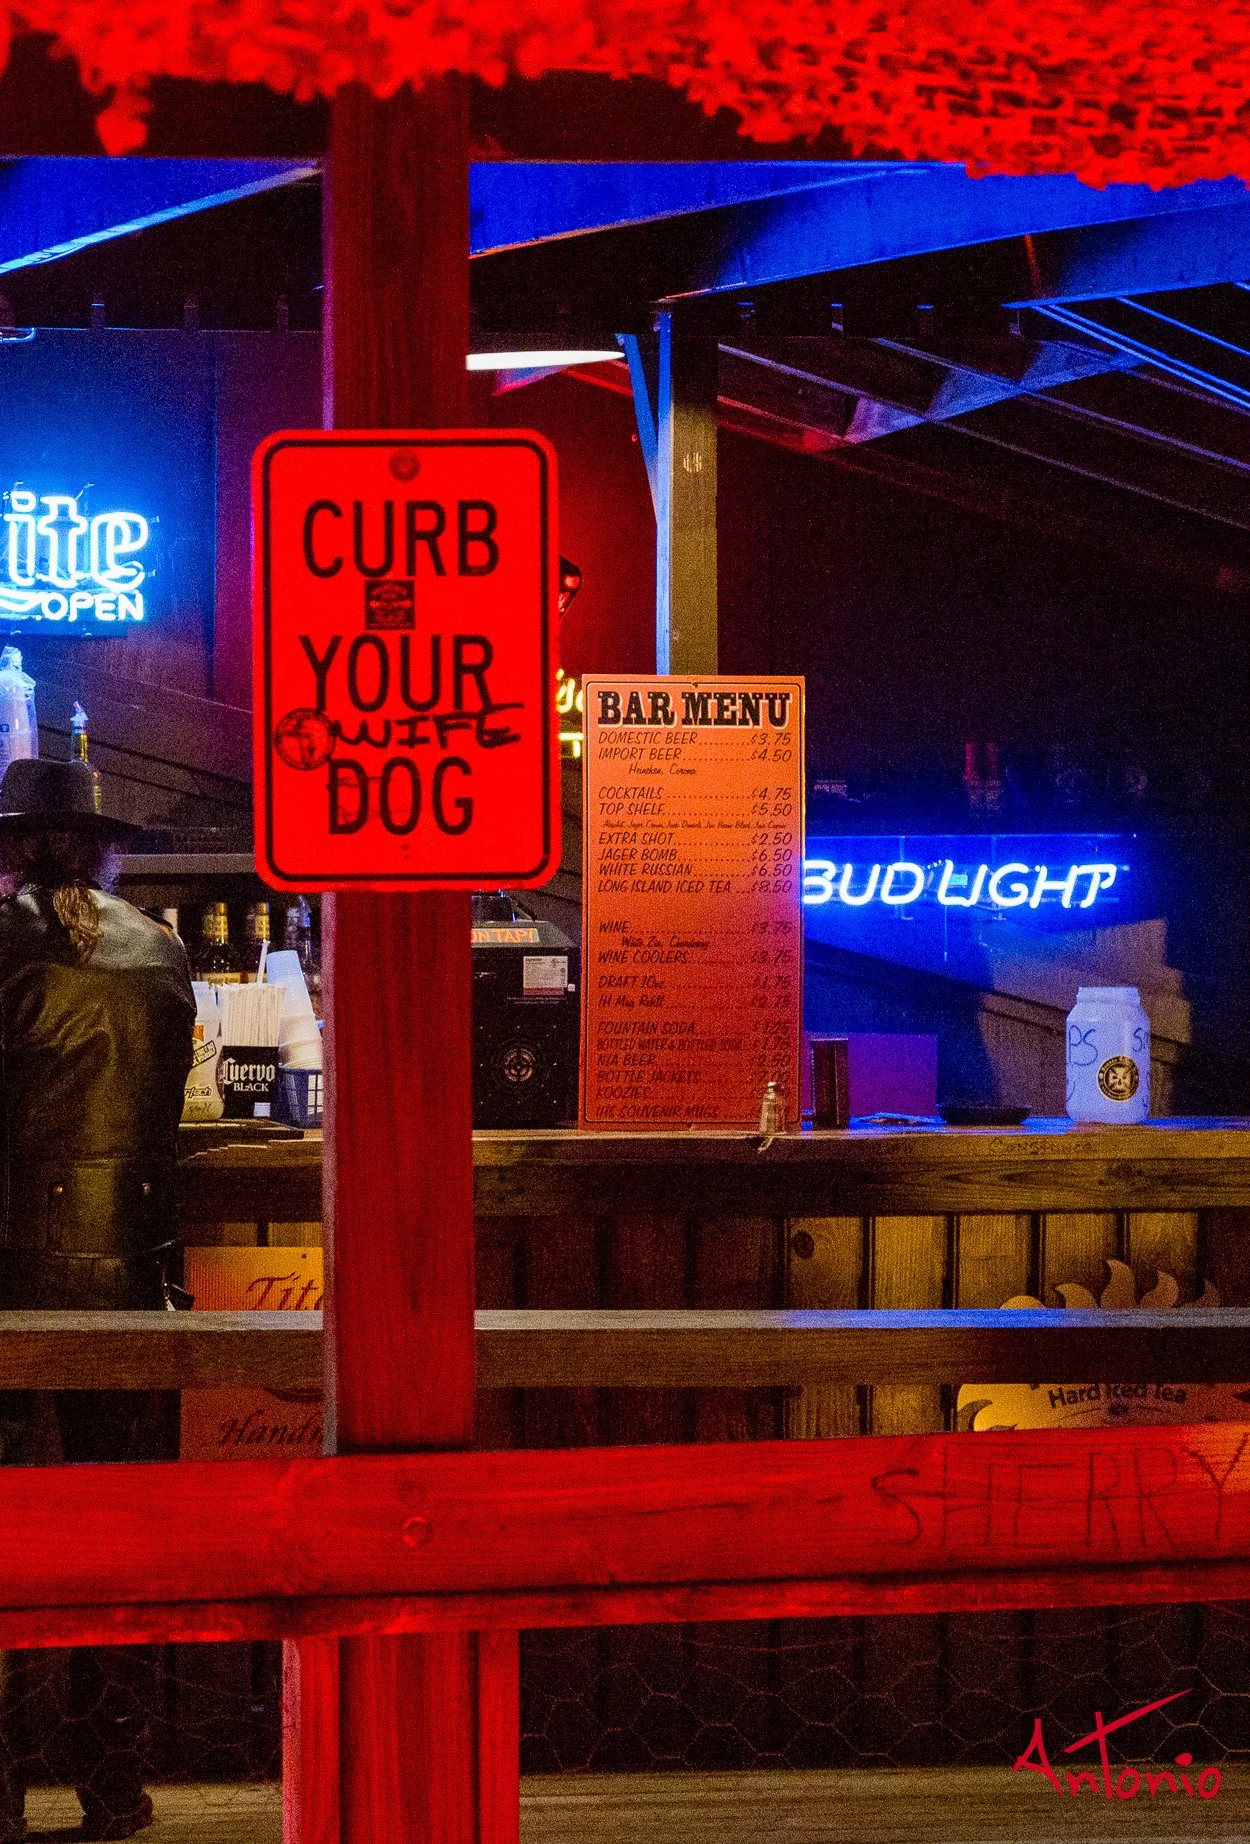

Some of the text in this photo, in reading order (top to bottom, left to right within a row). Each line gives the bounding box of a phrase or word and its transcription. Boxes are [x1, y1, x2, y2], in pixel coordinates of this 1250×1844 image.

[302, 499, 500, 578] CURB
[40, 591, 145, 623] OPEN
[298, 633, 498, 713] YOUR
[598, 691, 792, 728] BAR MENU
[333, 702, 525, 749] WIFE
[599, 732, 791, 745] DOMESTIC BEER $3.75
[599, 747, 792, 762] IMPORT BEER $4.50
[670, 764, 697, 774] Corona
[328, 756, 475, 836] DOG
[599, 787, 791, 800] COCKTAILS $4.75
[600, 803, 792, 816] TOP SHELF $5.50
[599, 833, 792, 845] EXTRA SHOT $2.50
[598, 849, 792, 862] JAGER BOMB $6.50
[599, 864, 792, 877] WHITE RUSSIAN $6.50
[598, 880, 792, 894] LONG ISLAND ICED TEA $8.50
[803, 859, 1118, 909] BUD LIGHT
[600, 921, 630, 933] WINE
[598, 950, 629, 964] WINE
[632, 950, 690, 964] COOLERS
[598, 976, 638, 989] DRAFT
[598, 1022, 657, 1035] FOUNTAIN
[661, 1021, 696, 1034] SODA
[222, 1057, 276, 1085] Cuervo
[233, 1082, 269, 1092] BLACK
[1048, 1383, 1100, 1409] Hard
